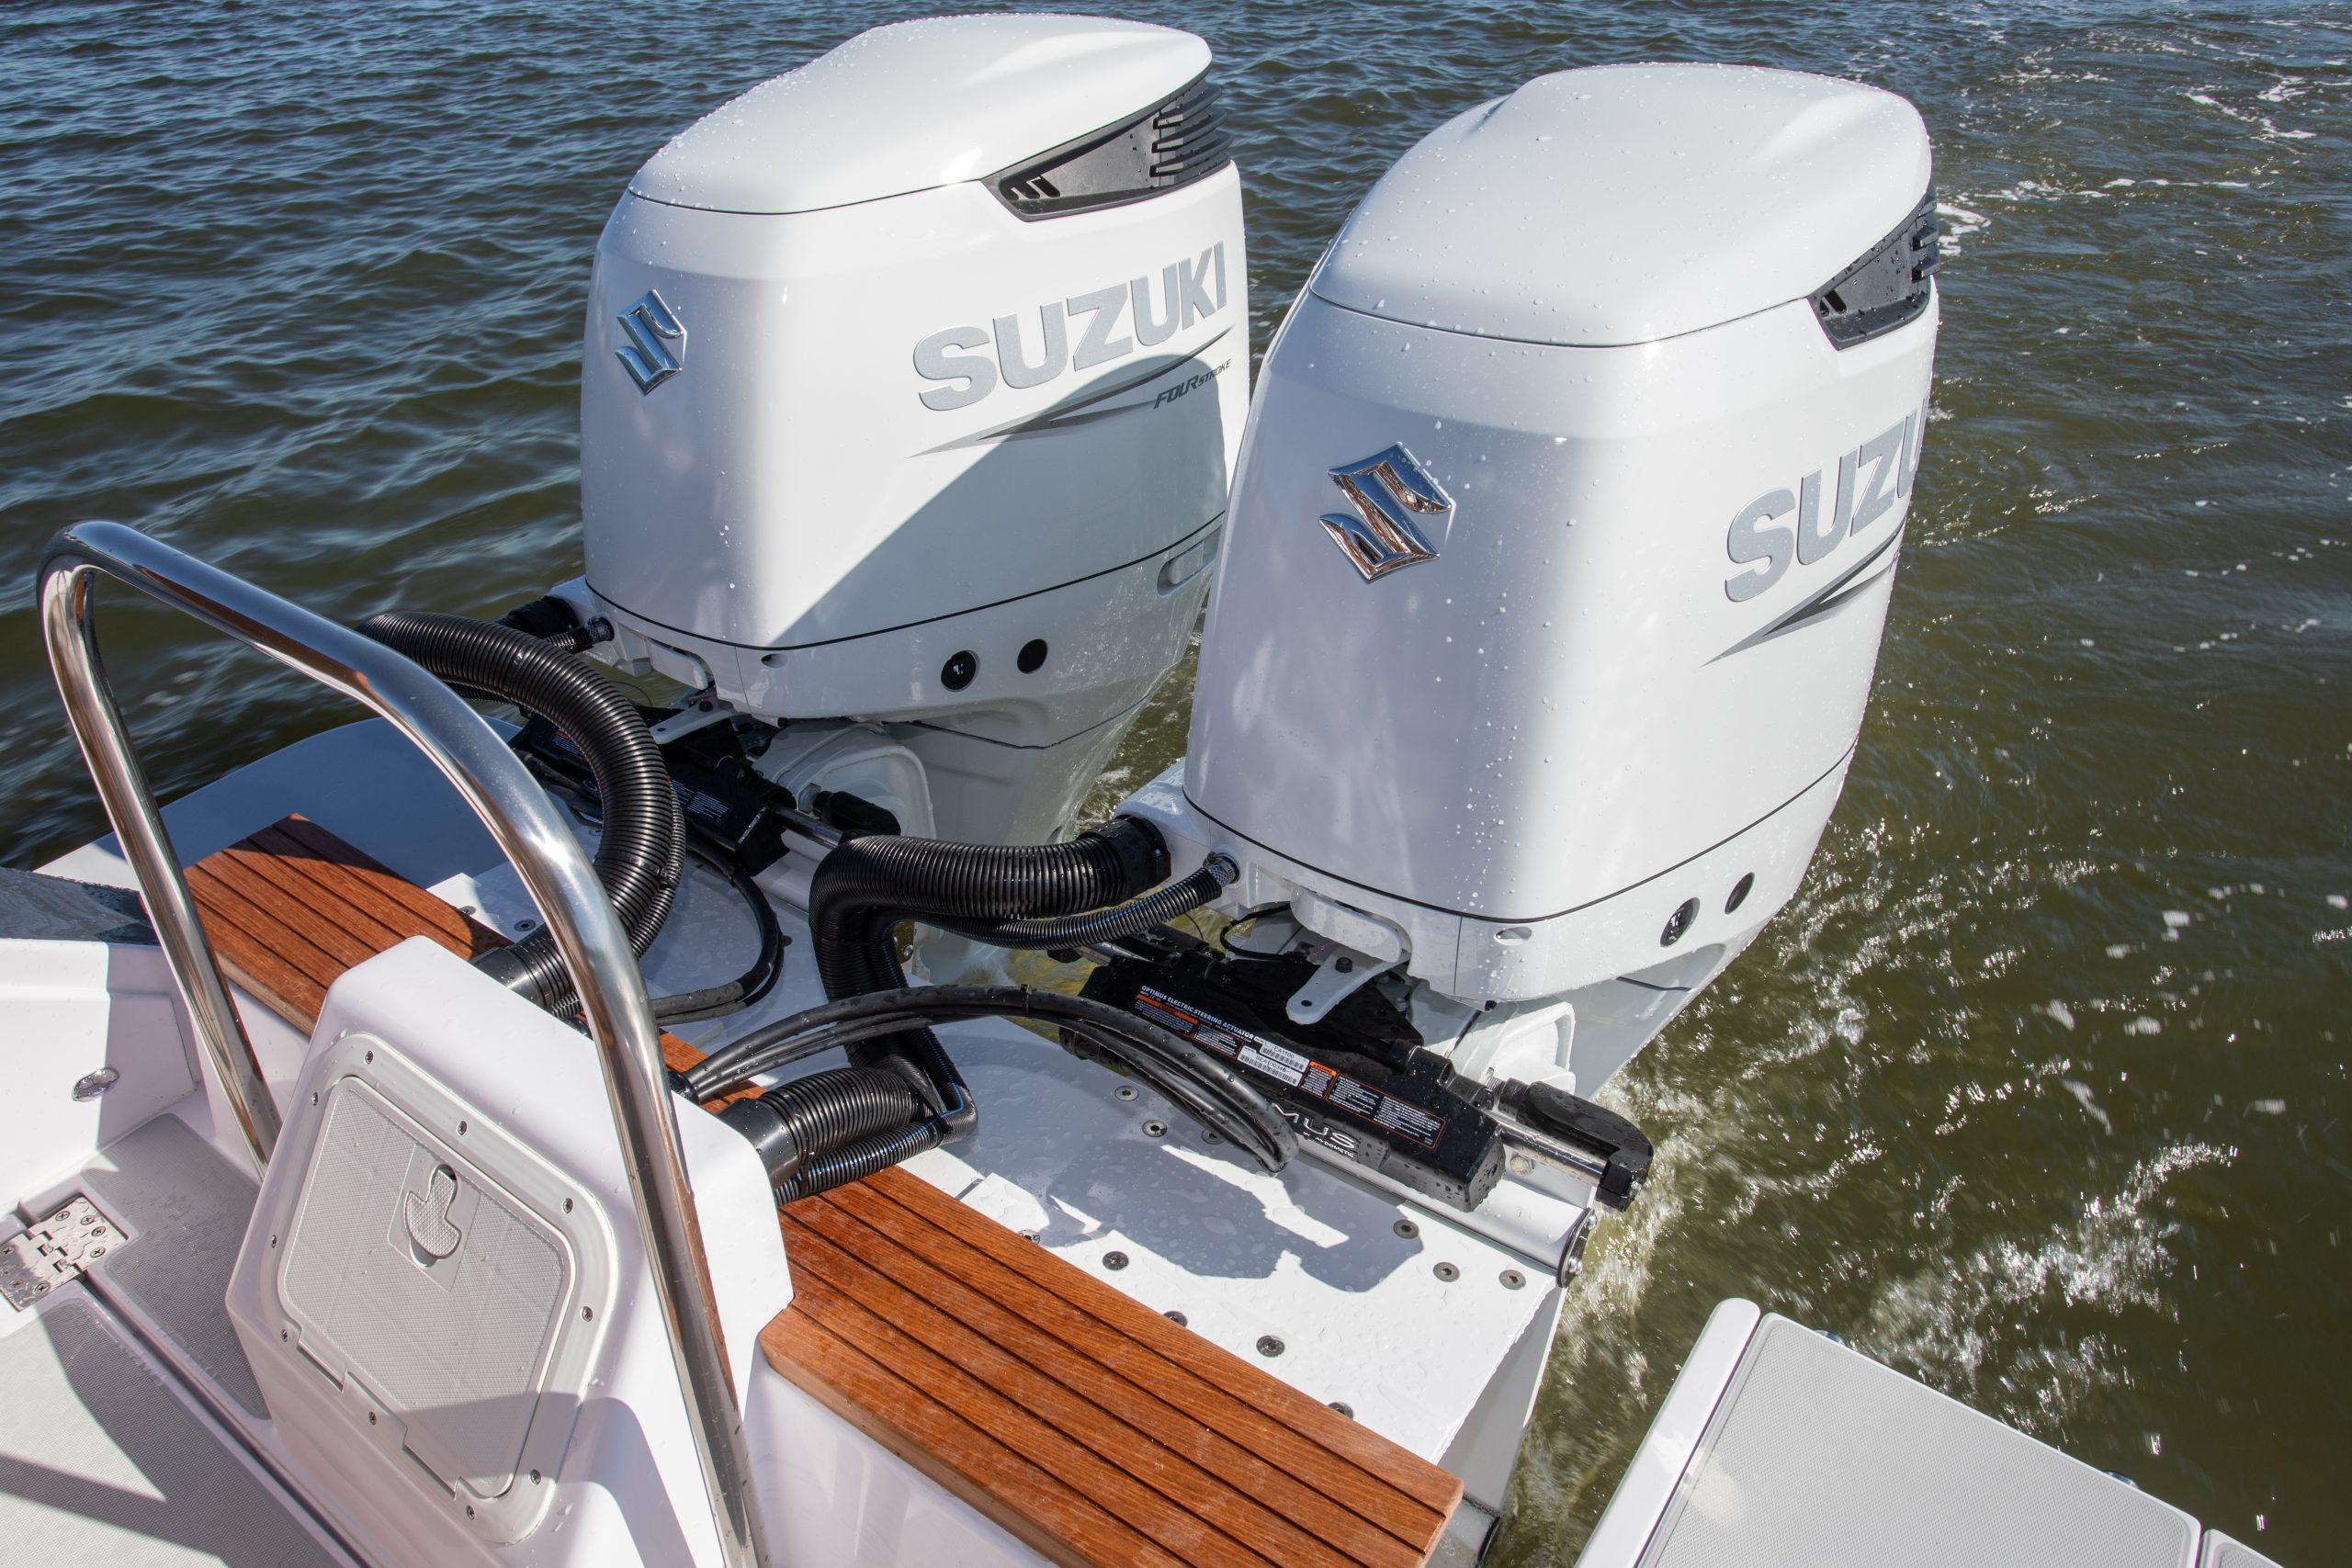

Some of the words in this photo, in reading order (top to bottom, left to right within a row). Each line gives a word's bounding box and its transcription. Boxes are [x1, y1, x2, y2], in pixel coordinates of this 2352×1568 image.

[912, 241, 1227, 412] SUZUKI
[1141, 985, 1168, 1000] OPTIMUS
[1167, 996, 1194, 1012] ELECTRIC
[1193, 1009, 1223, 1026] STEERING
[1222, 1021, 1255, 1039] ACTUATOR
[1324, 1141, 1355, 1158] DOMETIC
